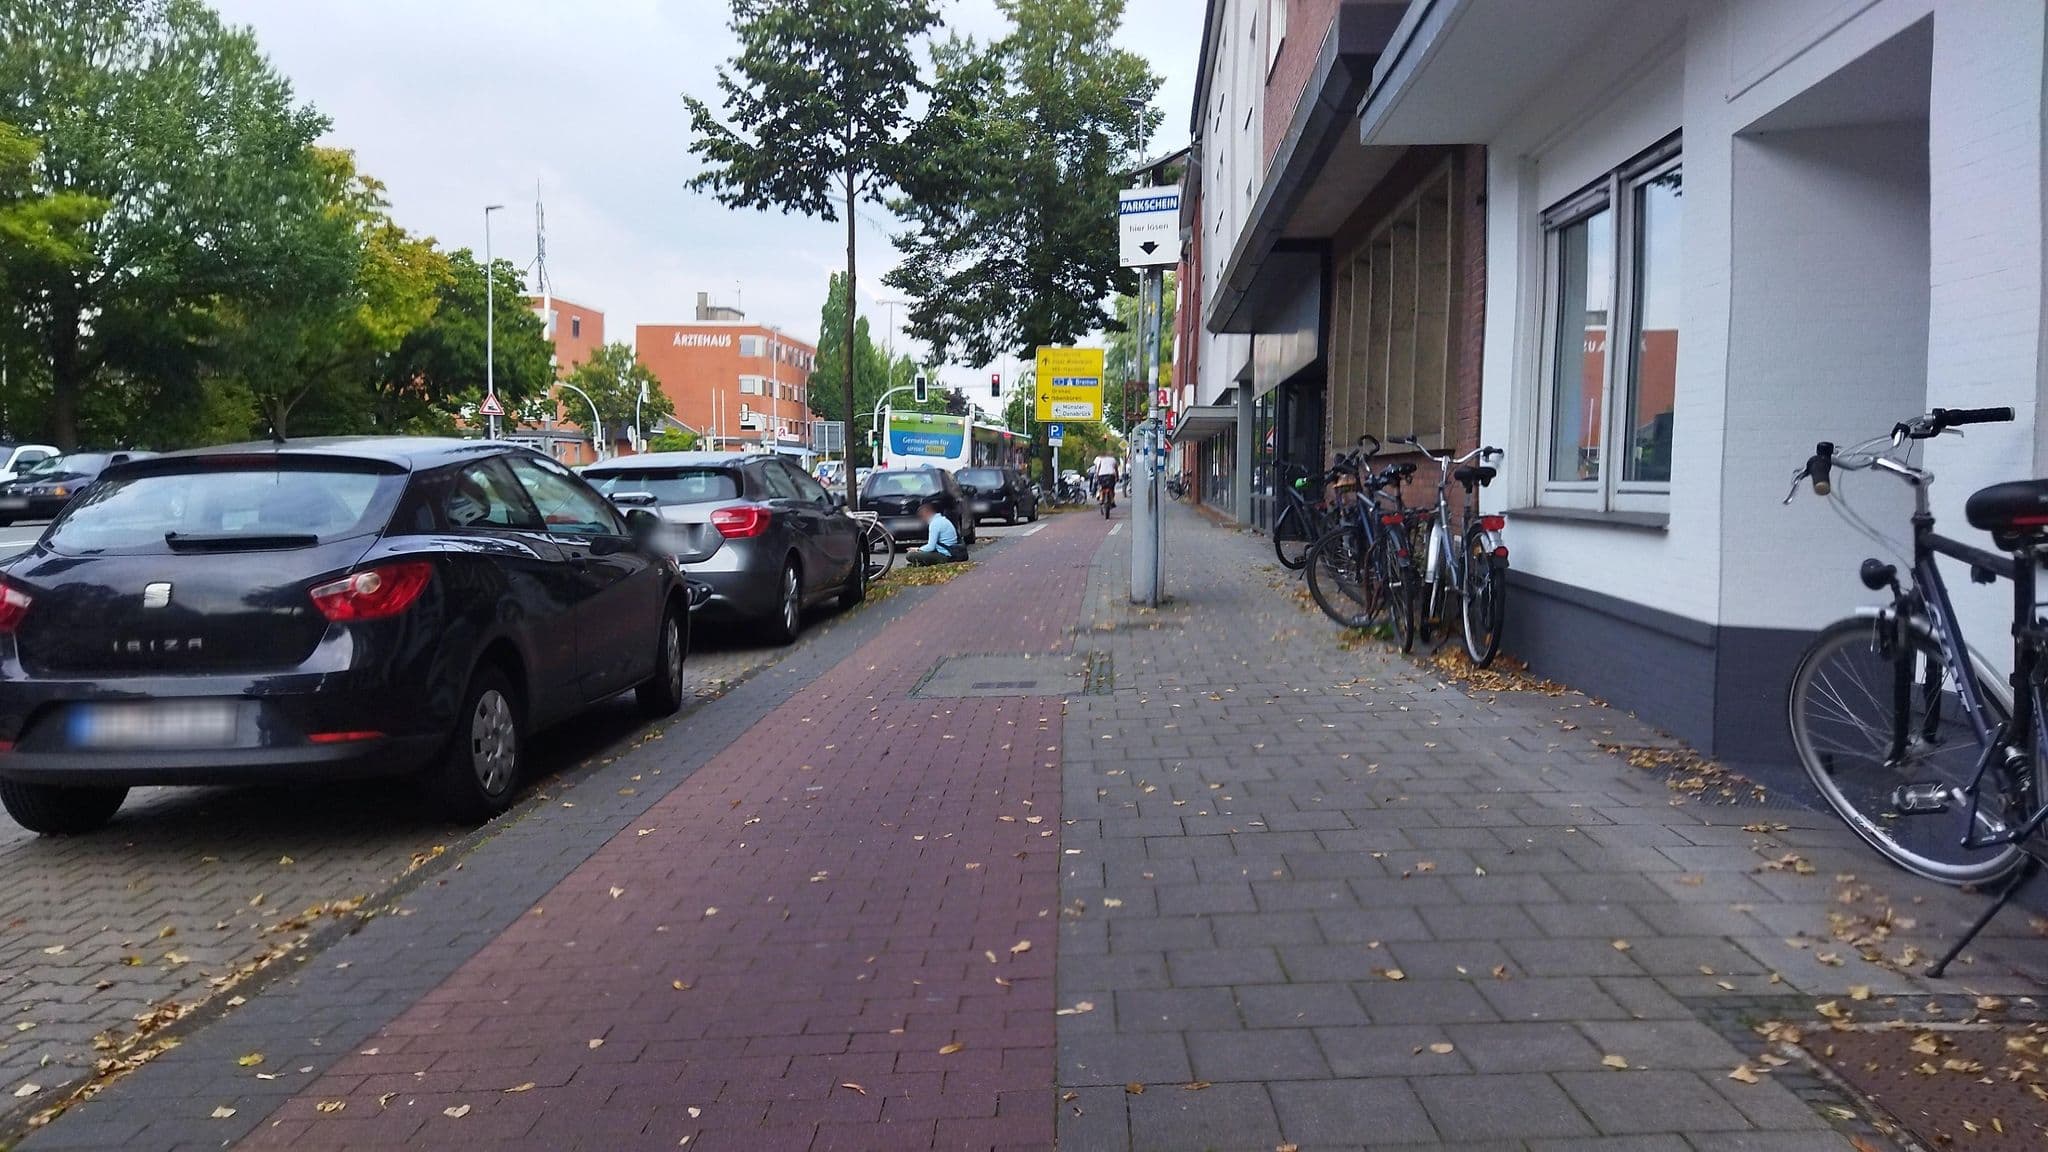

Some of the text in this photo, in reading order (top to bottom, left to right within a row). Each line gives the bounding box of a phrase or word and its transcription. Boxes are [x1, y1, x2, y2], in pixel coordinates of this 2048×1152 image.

[1121, 197, 1177, 213] PARKSCHEIN
[1147, 223, 1169, 231] lösen
[672, 331, 732, 347] ÄRZTEHAUS
[1050, 425, 1060, 436] P
[902, 436, 949, 446] Gemeinsam für
[113, 637, 202, 652] IBIZA
